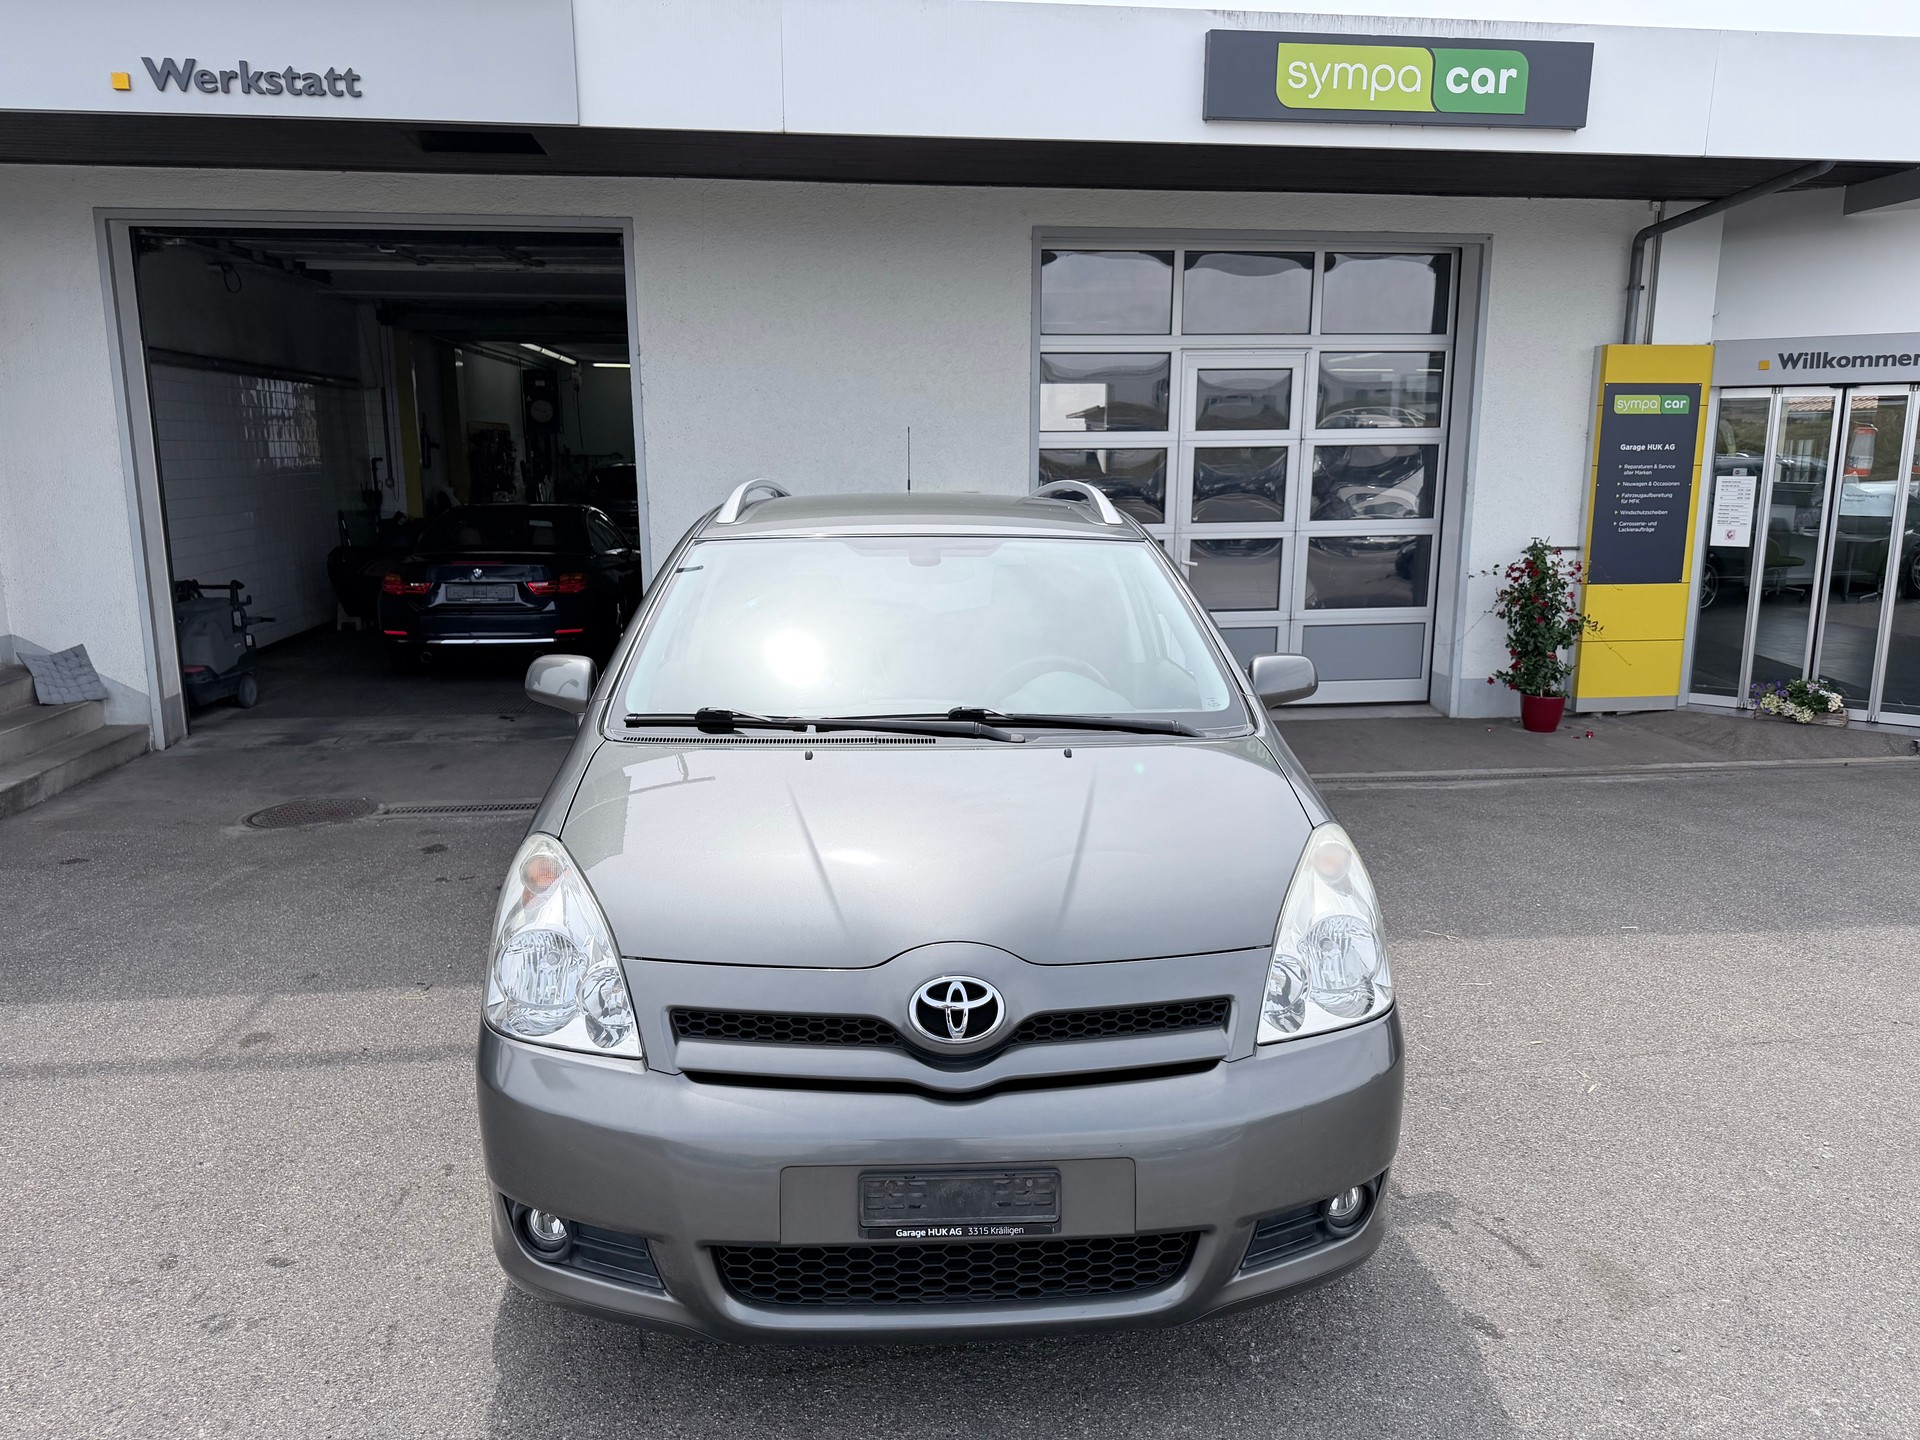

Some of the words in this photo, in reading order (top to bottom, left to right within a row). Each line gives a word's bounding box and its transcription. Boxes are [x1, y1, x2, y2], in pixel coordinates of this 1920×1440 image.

[141, 56, 362, 98] Werkstatt
[1287, 60, 1422, 101] sympa
[1445, 64, 1518, 95] car
[1617, 399, 1658, 411] sympa
[1664, 399, 1687, 409] car
[1620, 443, 1646, 452] Garage
[1647, 443, 1663, 451] HUK
[1664, 443, 1676, 451] AG
[895, 1228, 926, 1238] Garage
[927, 1228, 948, 1236] HUK
[949, 1227, 962, 1236] AG
[967, 1226, 989, 1235] 3315
[990, 1226, 1025, 1236] Kräiligen
